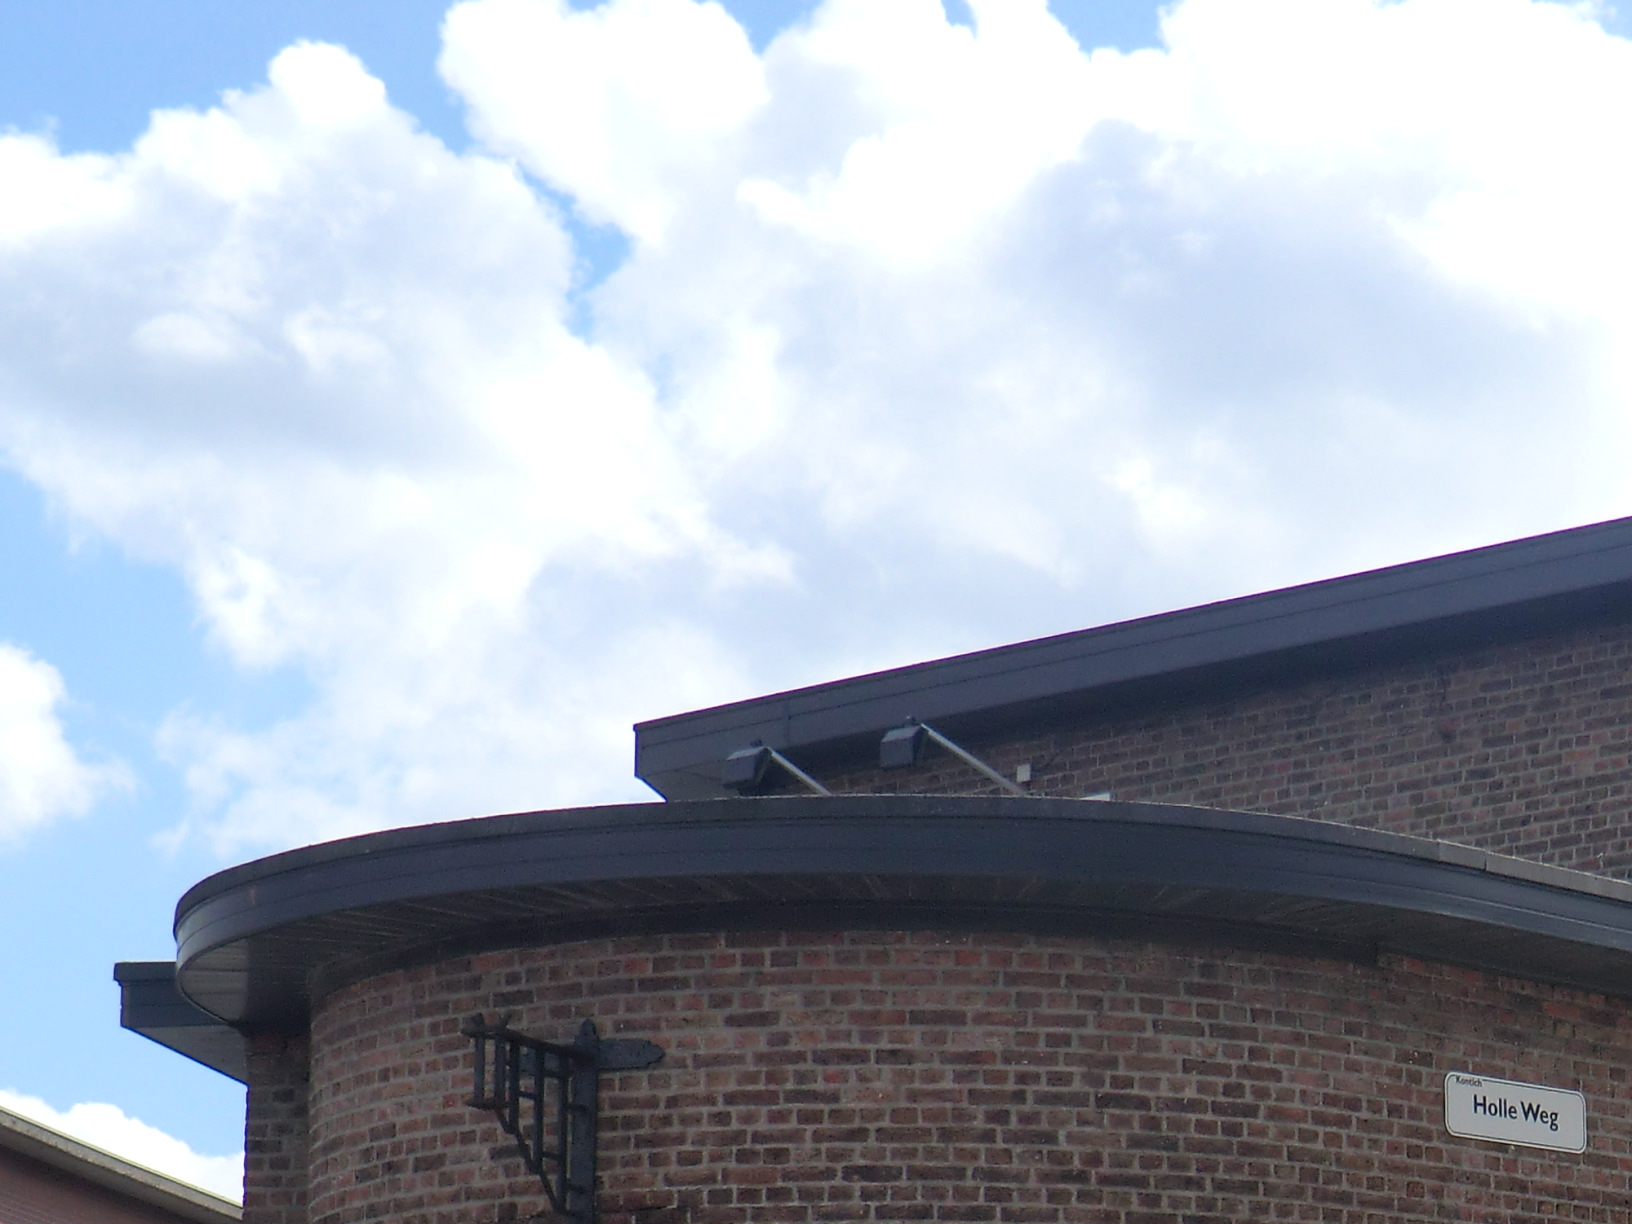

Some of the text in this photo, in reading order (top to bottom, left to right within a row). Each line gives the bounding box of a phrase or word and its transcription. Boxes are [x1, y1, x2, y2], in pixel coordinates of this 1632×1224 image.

[1455, 1075, 1483, 1088] Kontich
[1473, 1094, 1559, 1132] Holle Weg
